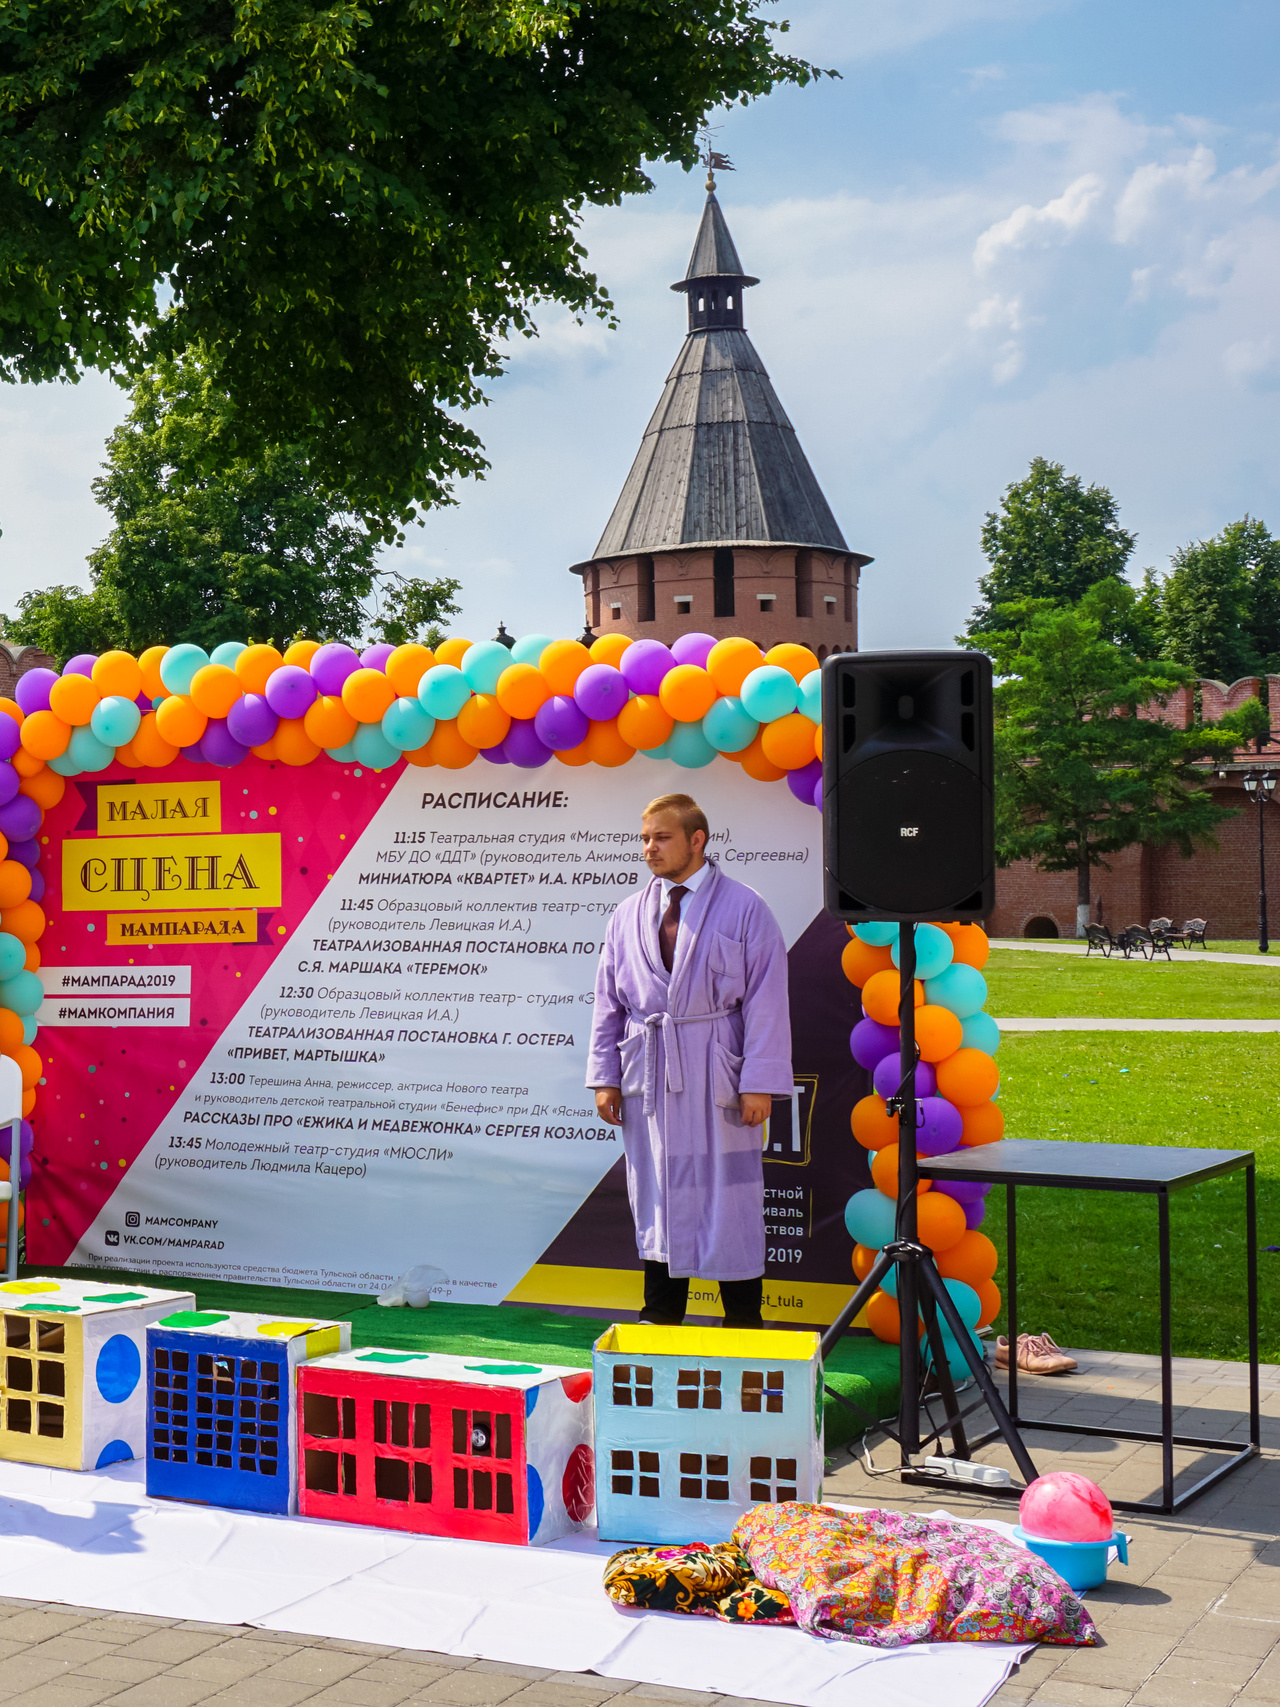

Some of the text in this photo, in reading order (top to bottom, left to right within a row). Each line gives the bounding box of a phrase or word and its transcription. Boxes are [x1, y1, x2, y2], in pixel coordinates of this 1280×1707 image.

[107, 796, 210, 822] МАЛАЯ
[421, 791, 569, 809] РАСПИСАНИЕ:
[393, 831, 426, 844] 11:15
[429, 831, 515, 847] Театральная
[518, 834, 566, 847] студия
[900, 827, 919, 837] RCF
[376, 850, 406, 863] МБУ
[408, 850, 431, 865] ДО
[435, 850, 477, 865] «ДДТ»
[480, 849, 582, 867] (руководитель
[585, 850, 645, 863] Акимова
[725, 848, 810, 865] Сергеевна)
[80, 852, 261, 901] СЦЕНА
[358, 872, 639, 886] МИНИАТЮРА «КВАРТЕТ» И.А. КРЫЛОВ
[340, 898, 618, 916] 11:45 Образцовый коллектив театр-студ
[120, 919, 246, 937] МАМПАРАДА
[328, 918, 532, 934] (руководитель Левицкая И.А.)
[312, 939, 463, 953] ТЕАТРАЛИЗОВАННАЯ
[465, 941, 569, 955] ПОСТАНОВКА
[572, 942, 595, 955] ПО
[297, 961, 488, 976] С.Я. МАРШАКА «ТЕРЕМОК»
[61, 974, 177, 989] #МАМПАРАД2019
[279, 986, 315, 999] 12:30
[317, 987, 402, 1003] Образцовый
[404, 991, 475, 1003] коллектив
[479, 993, 523, 1007] театр-
[526, 993, 574, 1008] студия
[58, 1006, 175, 1020] #МАМКОМПАНИЯ
[260, 1004, 460, 1024] (руководитель Левицкая И.А.)
[248, 1026, 575, 1047] ТЕАТРАЛИЗОВАННАЯ ПОСТАНОВКА Г. ОСТЕРА
[227, 1047, 386, 1063] «ПРИВЕТ, МАРТЫШКА»
[210, 1072, 246, 1085] 13:00
[249, 1075, 302, 1088] Терешина
[397, 1083, 443, 1095] актриса
[446, 1082, 488, 1094] Нового
[491, 1086, 529, 1097] театра
[195, 1094, 201, 1102] и
[204, 1095, 278, 1106] руководитель
[280, 1096, 325, 1107] детской
[327, 1098, 396, 1111] театральной
[398, 1102, 438, 1113] студии
[440, 1102, 504, 1116] «Бенефис»
[507, 1105, 529, 1116] при
[531, 1104, 549, 1117] ДК
[552, 1105, 594, 1118] «Ясная
[183, 1111, 617, 1141] РАССКАЗЫ ПРО «ЕЖИКА И МЕДВЕЖОНКА» СЕРГЕЯ КОЗЛОВА
[168, 1136, 454, 1161] 13:45 Молодежный театр-студия «МЮСЛИ»
[154, 1153, 367, 1178] (руководитель Людмила Кацеро)
[763, 1186, 803, 1200] стной
[763, 1207, 804, 1218] иваль
[145, 1216, 219, 1229] MAMCOMPANY
[764, 1225, 804, 1236] ствов
[123, 1235, 225, 1250] VK.COM/MAMPARAD
[767, 1247, 803, 1264] 2019
[88, 1253, 103, 1263] При
[104, 1255, 151, 1266] реализации
[152, 1259, 184, 1269] проекта
[185, 1261, 241, 1272] используются
[243, 1265, 280, 1274] средства
[281, 1266, 318, 1276] бюджета
[320, 1268, 357, 1279] Тульской
[459, 1280, 498, 1289] качестве
[158, 1269, 221, 1279] распоряжением
[223, 1273, 281, 1283] правительства
[283, 1276, 320, 1286] Тульской
[321, 1280, 356, 1289] области
